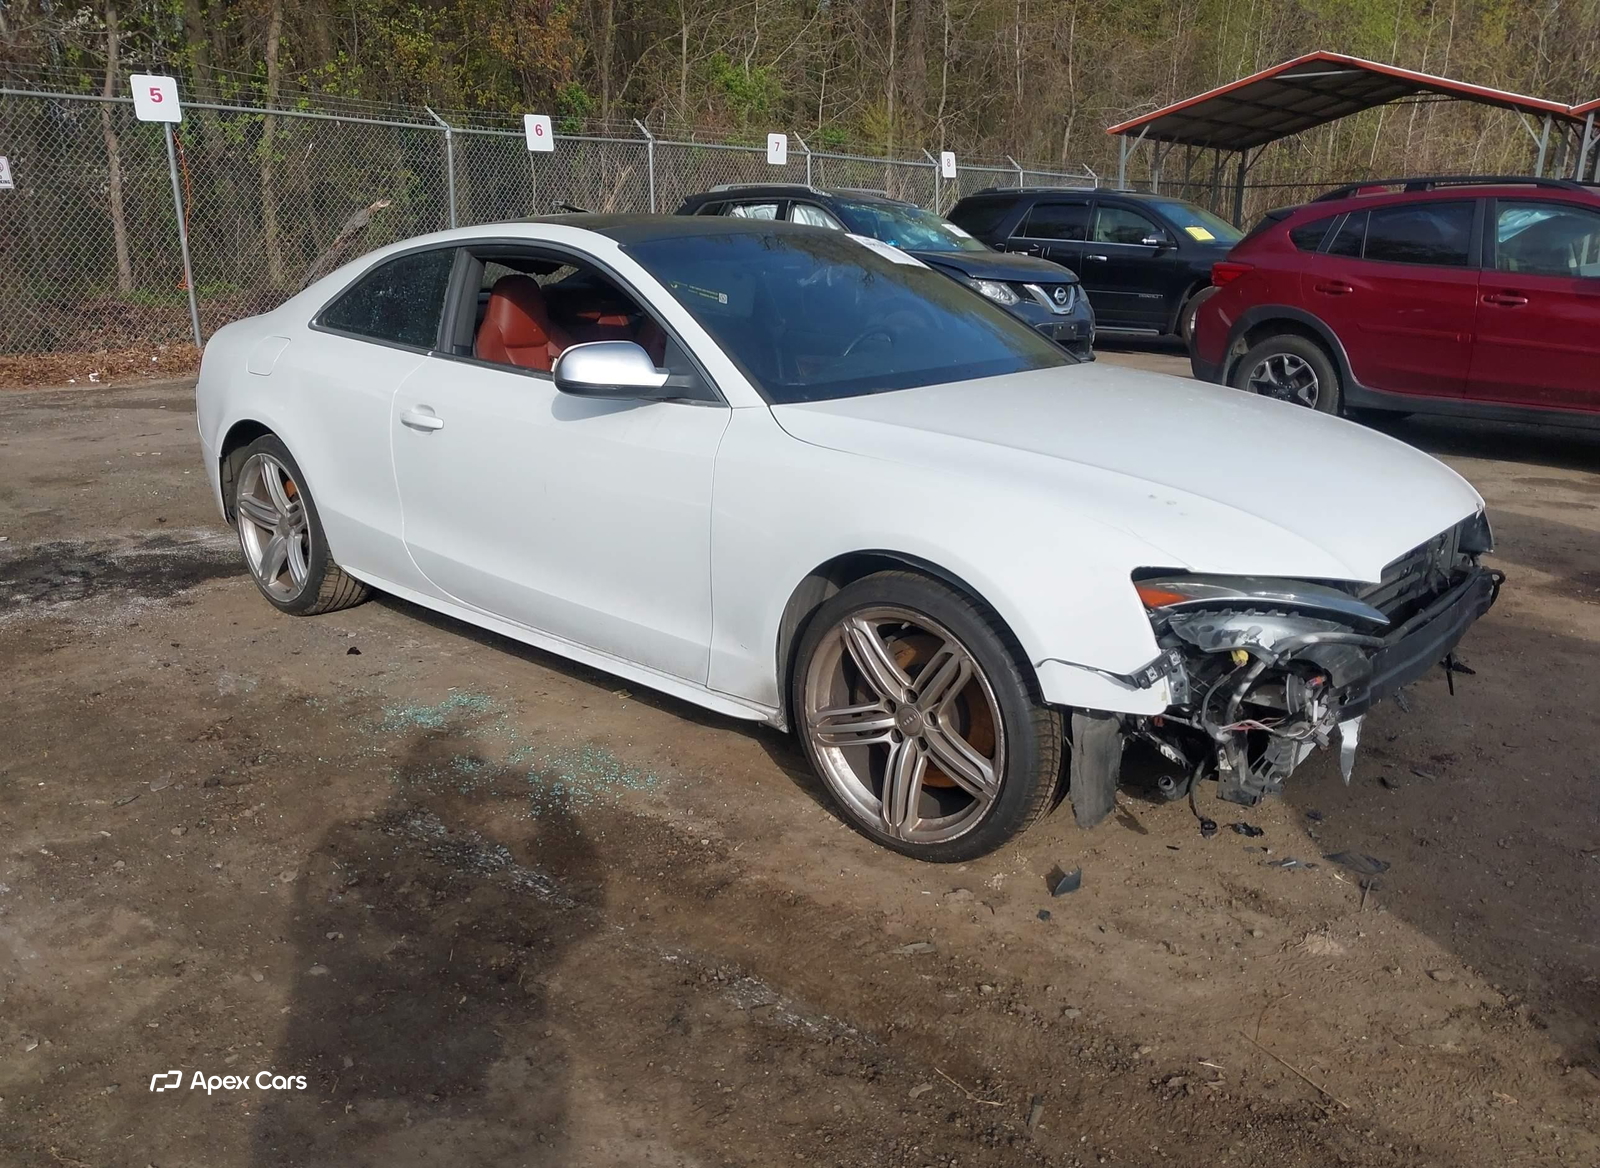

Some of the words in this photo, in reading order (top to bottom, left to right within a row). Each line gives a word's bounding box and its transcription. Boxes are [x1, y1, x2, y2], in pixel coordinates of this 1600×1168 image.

[149, 87, 163, 103] 5
[535, 123, 543, 137] 6
[775, 141, 780, 152] 7
[946, 158, 951, 168] 8
